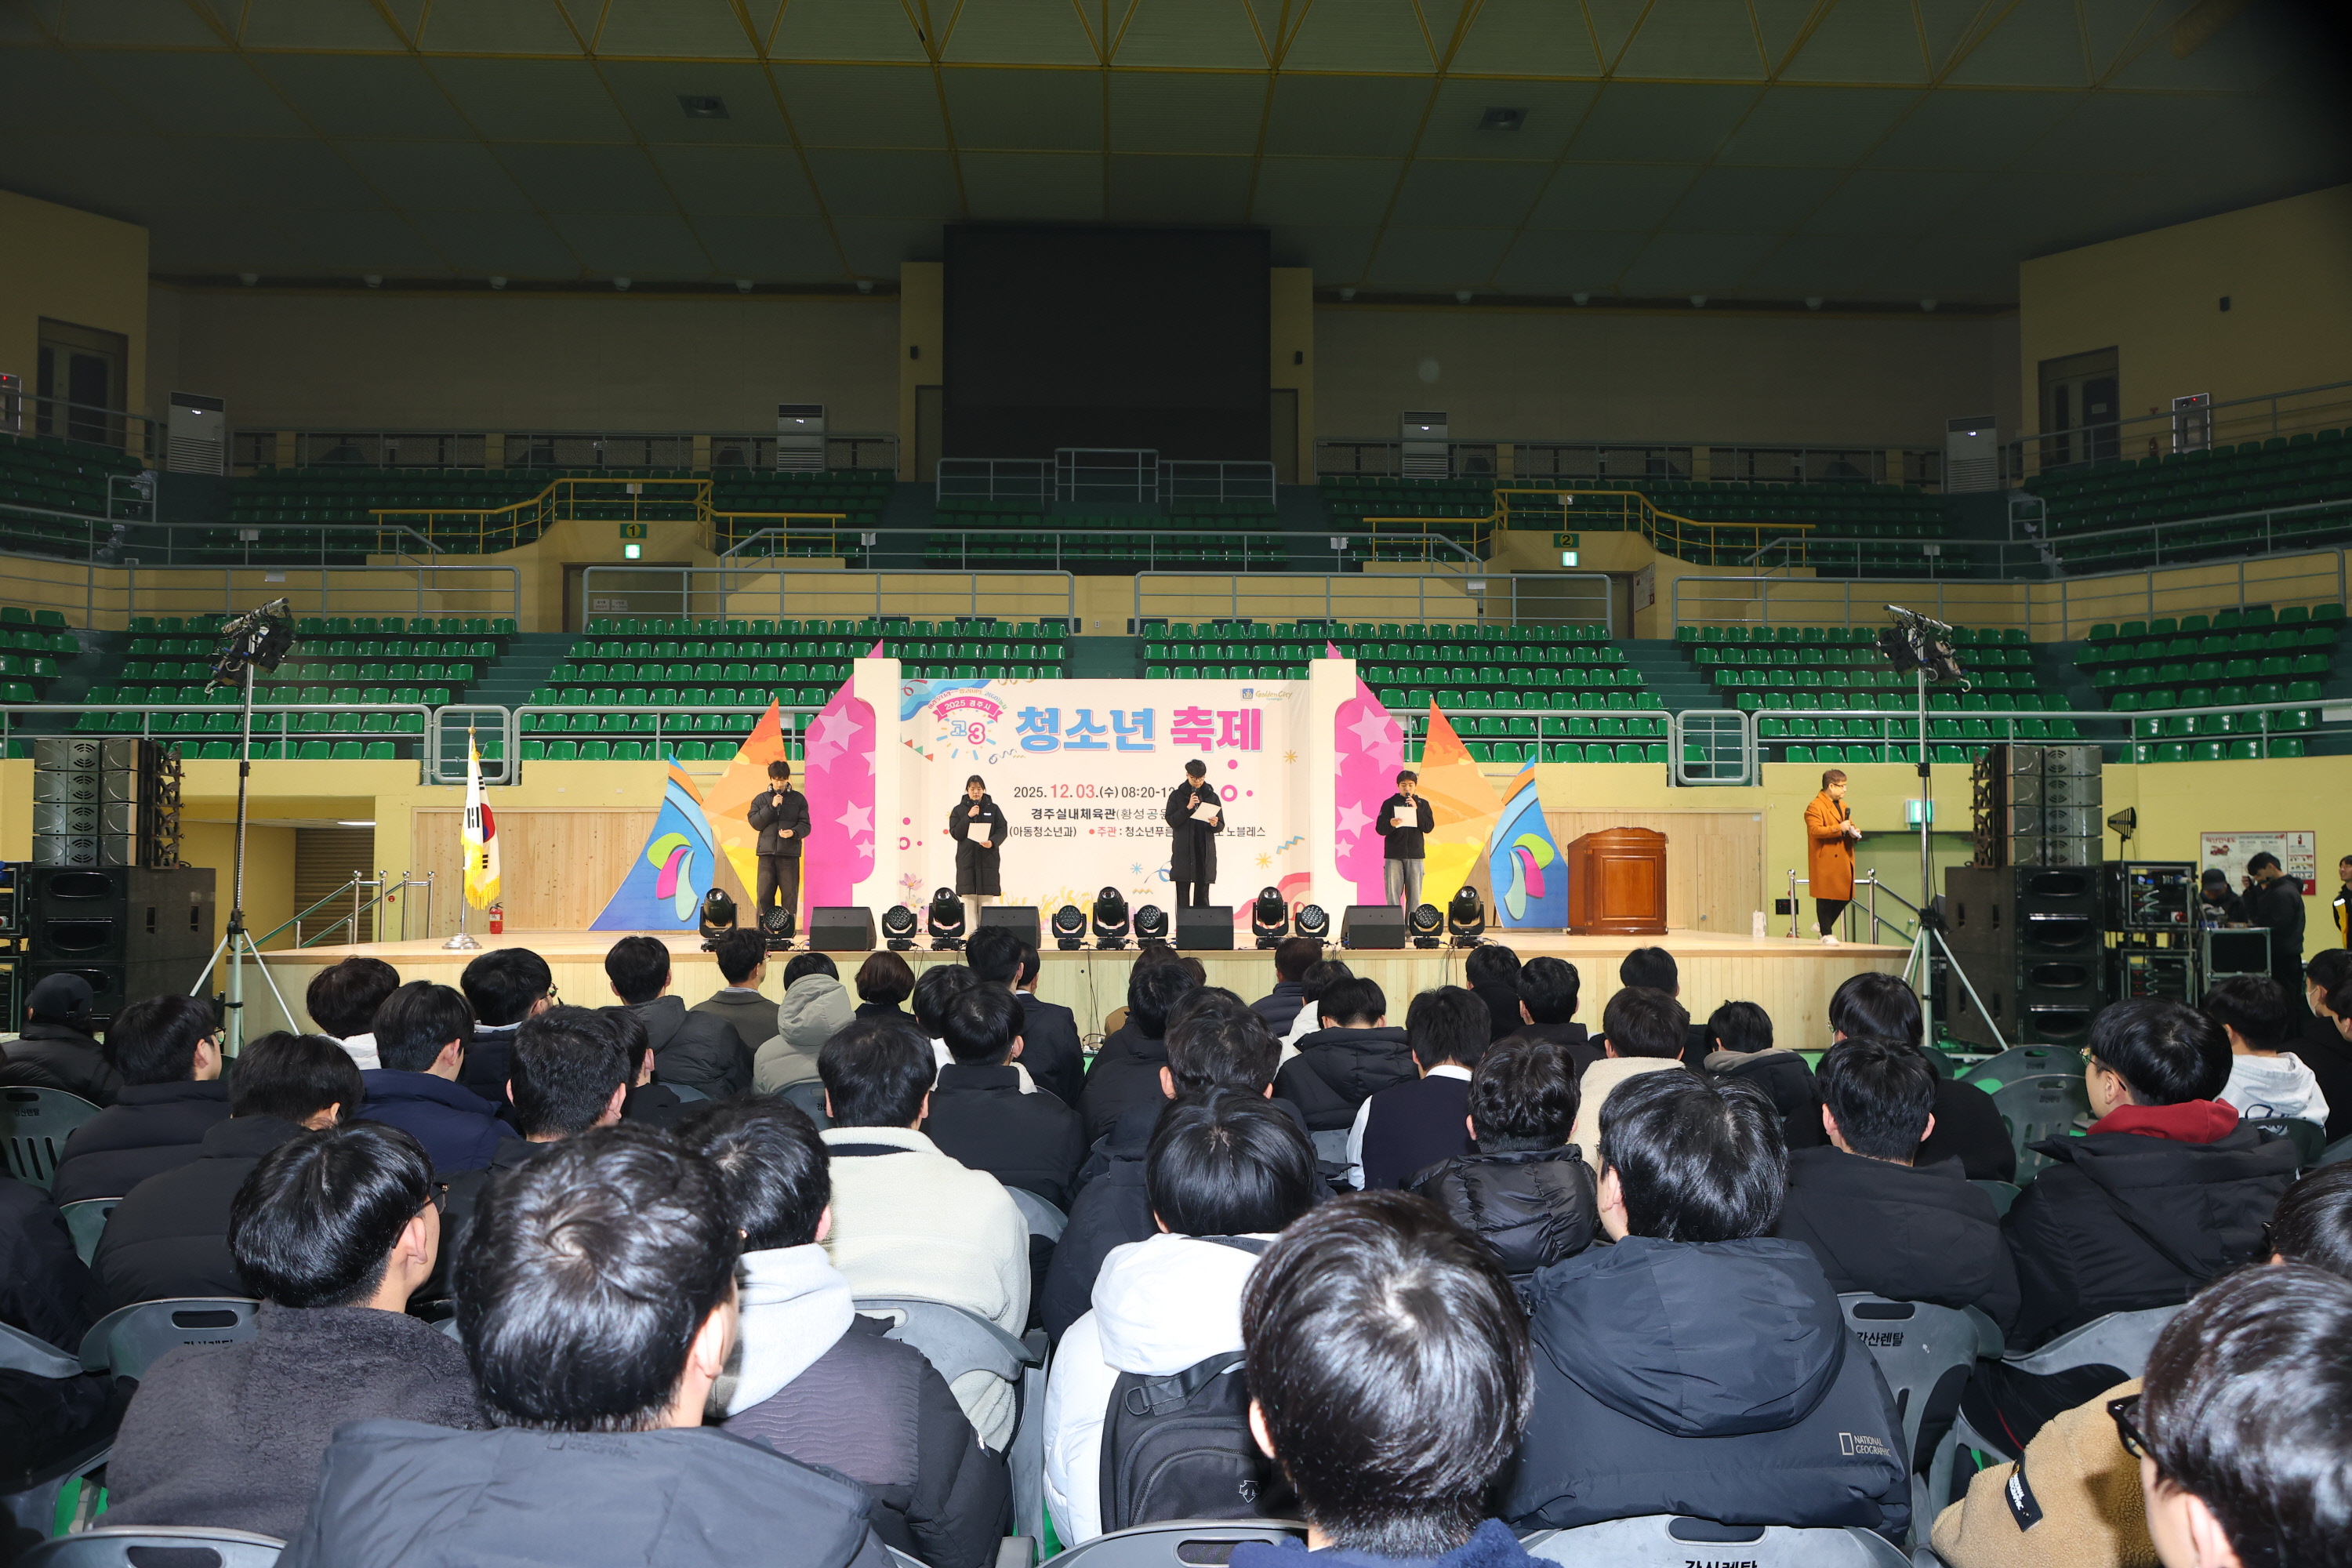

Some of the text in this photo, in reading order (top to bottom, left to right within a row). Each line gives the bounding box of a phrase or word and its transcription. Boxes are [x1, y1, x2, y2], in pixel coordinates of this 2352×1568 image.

[630, 525, 635, 536] 1
[1563, 535, 1571, 546] 2
[944, 699, 992, 711] 2025 경주시
[1015, 706, 1263, 753] 청소년 축제
[1014, 786, 1047, 798] 2025.
[1098, 826, 1117, 837] 주관
[1227, 826, 1266, 837] 노블레스
[1853, 1435, 1884, 1446] NATIONAL
[1855, 1444, 1892, 1457] GEOGRAPHIC
